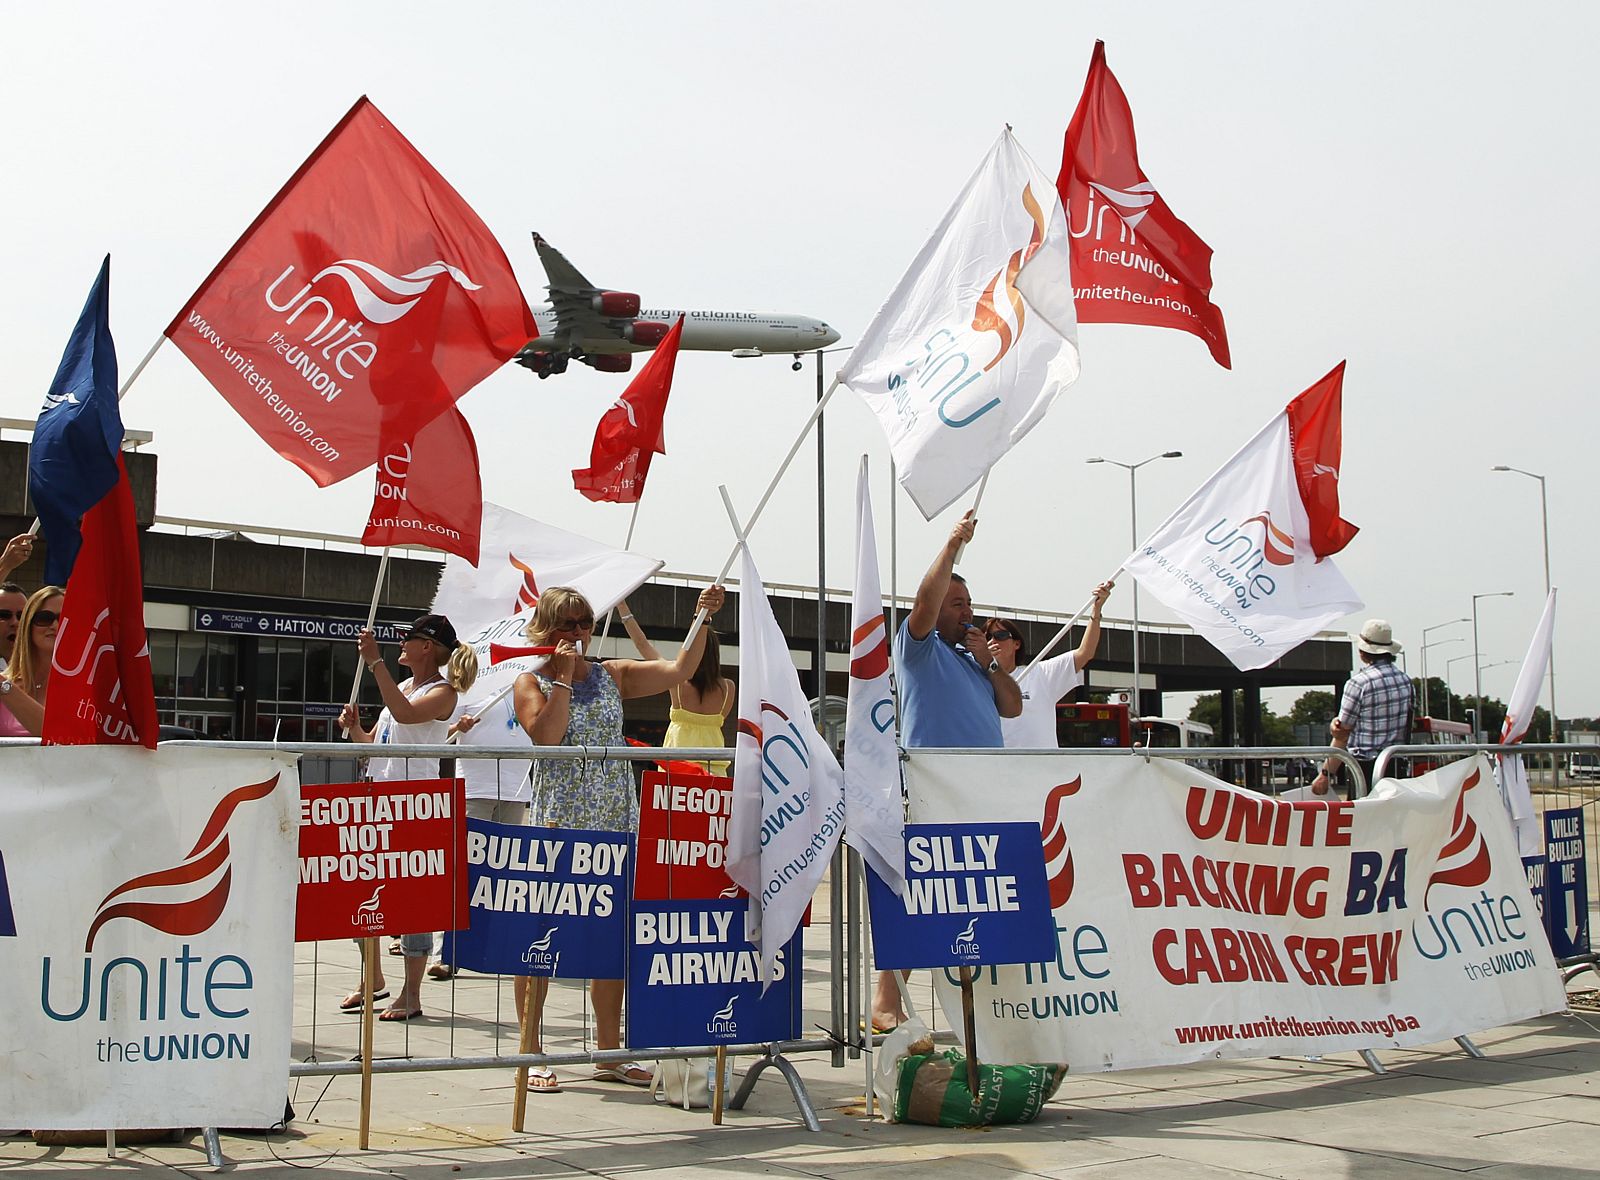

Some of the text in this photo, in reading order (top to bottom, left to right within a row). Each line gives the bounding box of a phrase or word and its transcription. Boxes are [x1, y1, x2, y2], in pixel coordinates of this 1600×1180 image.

[265, 265, 378, 380] unite
[640, 309, 757, 320] virgin atlantic
[266, 331, 342, 402] theUNION
[188, 310, 340, 462] www.unitetheunion.com
[1204, 518, 1276, 600] unite
[1142, 545, 1266, 647] www.unitetheunion.com
[1200, 555, 1252, 609] theUNION
[222, 614, 253, 623] PICCADILLY
[274, 618, 325, 635] HATTON
[299, 792, 451, 826] EGOTIATION
[1186, 785, 1355, 847] UNITE
[338, 823, 393, 853] NOT
[1550, 816, 1579, 839] WILLIE
[297, 849, 446, 884] MPOSITION
[467, 830, 627, 877] BULLY BOY
[909, 834, 999, 873] SILLY
[1548, 839, 1583, 863] BULLIED
[1122, 848, 1408, 920] BACKING BA
[1527, 864, 1545, 889] BOY
[1562, 863, 1576, 885] ME
[470, 876, 613, 918] AIRWAYS
[904, 875, 1020, 916] WILLIE
[351, 912, 384, 925] unite
[635, 911, 733, 945] BULLY
[1411, 890, 1527, 961] unite
[521, 951, 552, 964] unite
[951, 943, 980, 955] unite
[1152, 928, 1402, 988] CABIN CREW
[1464, 948, 1536, 982] theUNION
[42, 944, 253, 1021] unite
[648, 950, 785, 985] AIRWAYS
[992, 990, 1119, 1021] theUNION
[706, 1020, 737, 1033] unite
[1174, 1014, 1421, 1045] www.unitetheunion.org/ba
[97, 1032, 250, 1062] theUNION
[984, 1068, 1004, 1122] ALLAST
